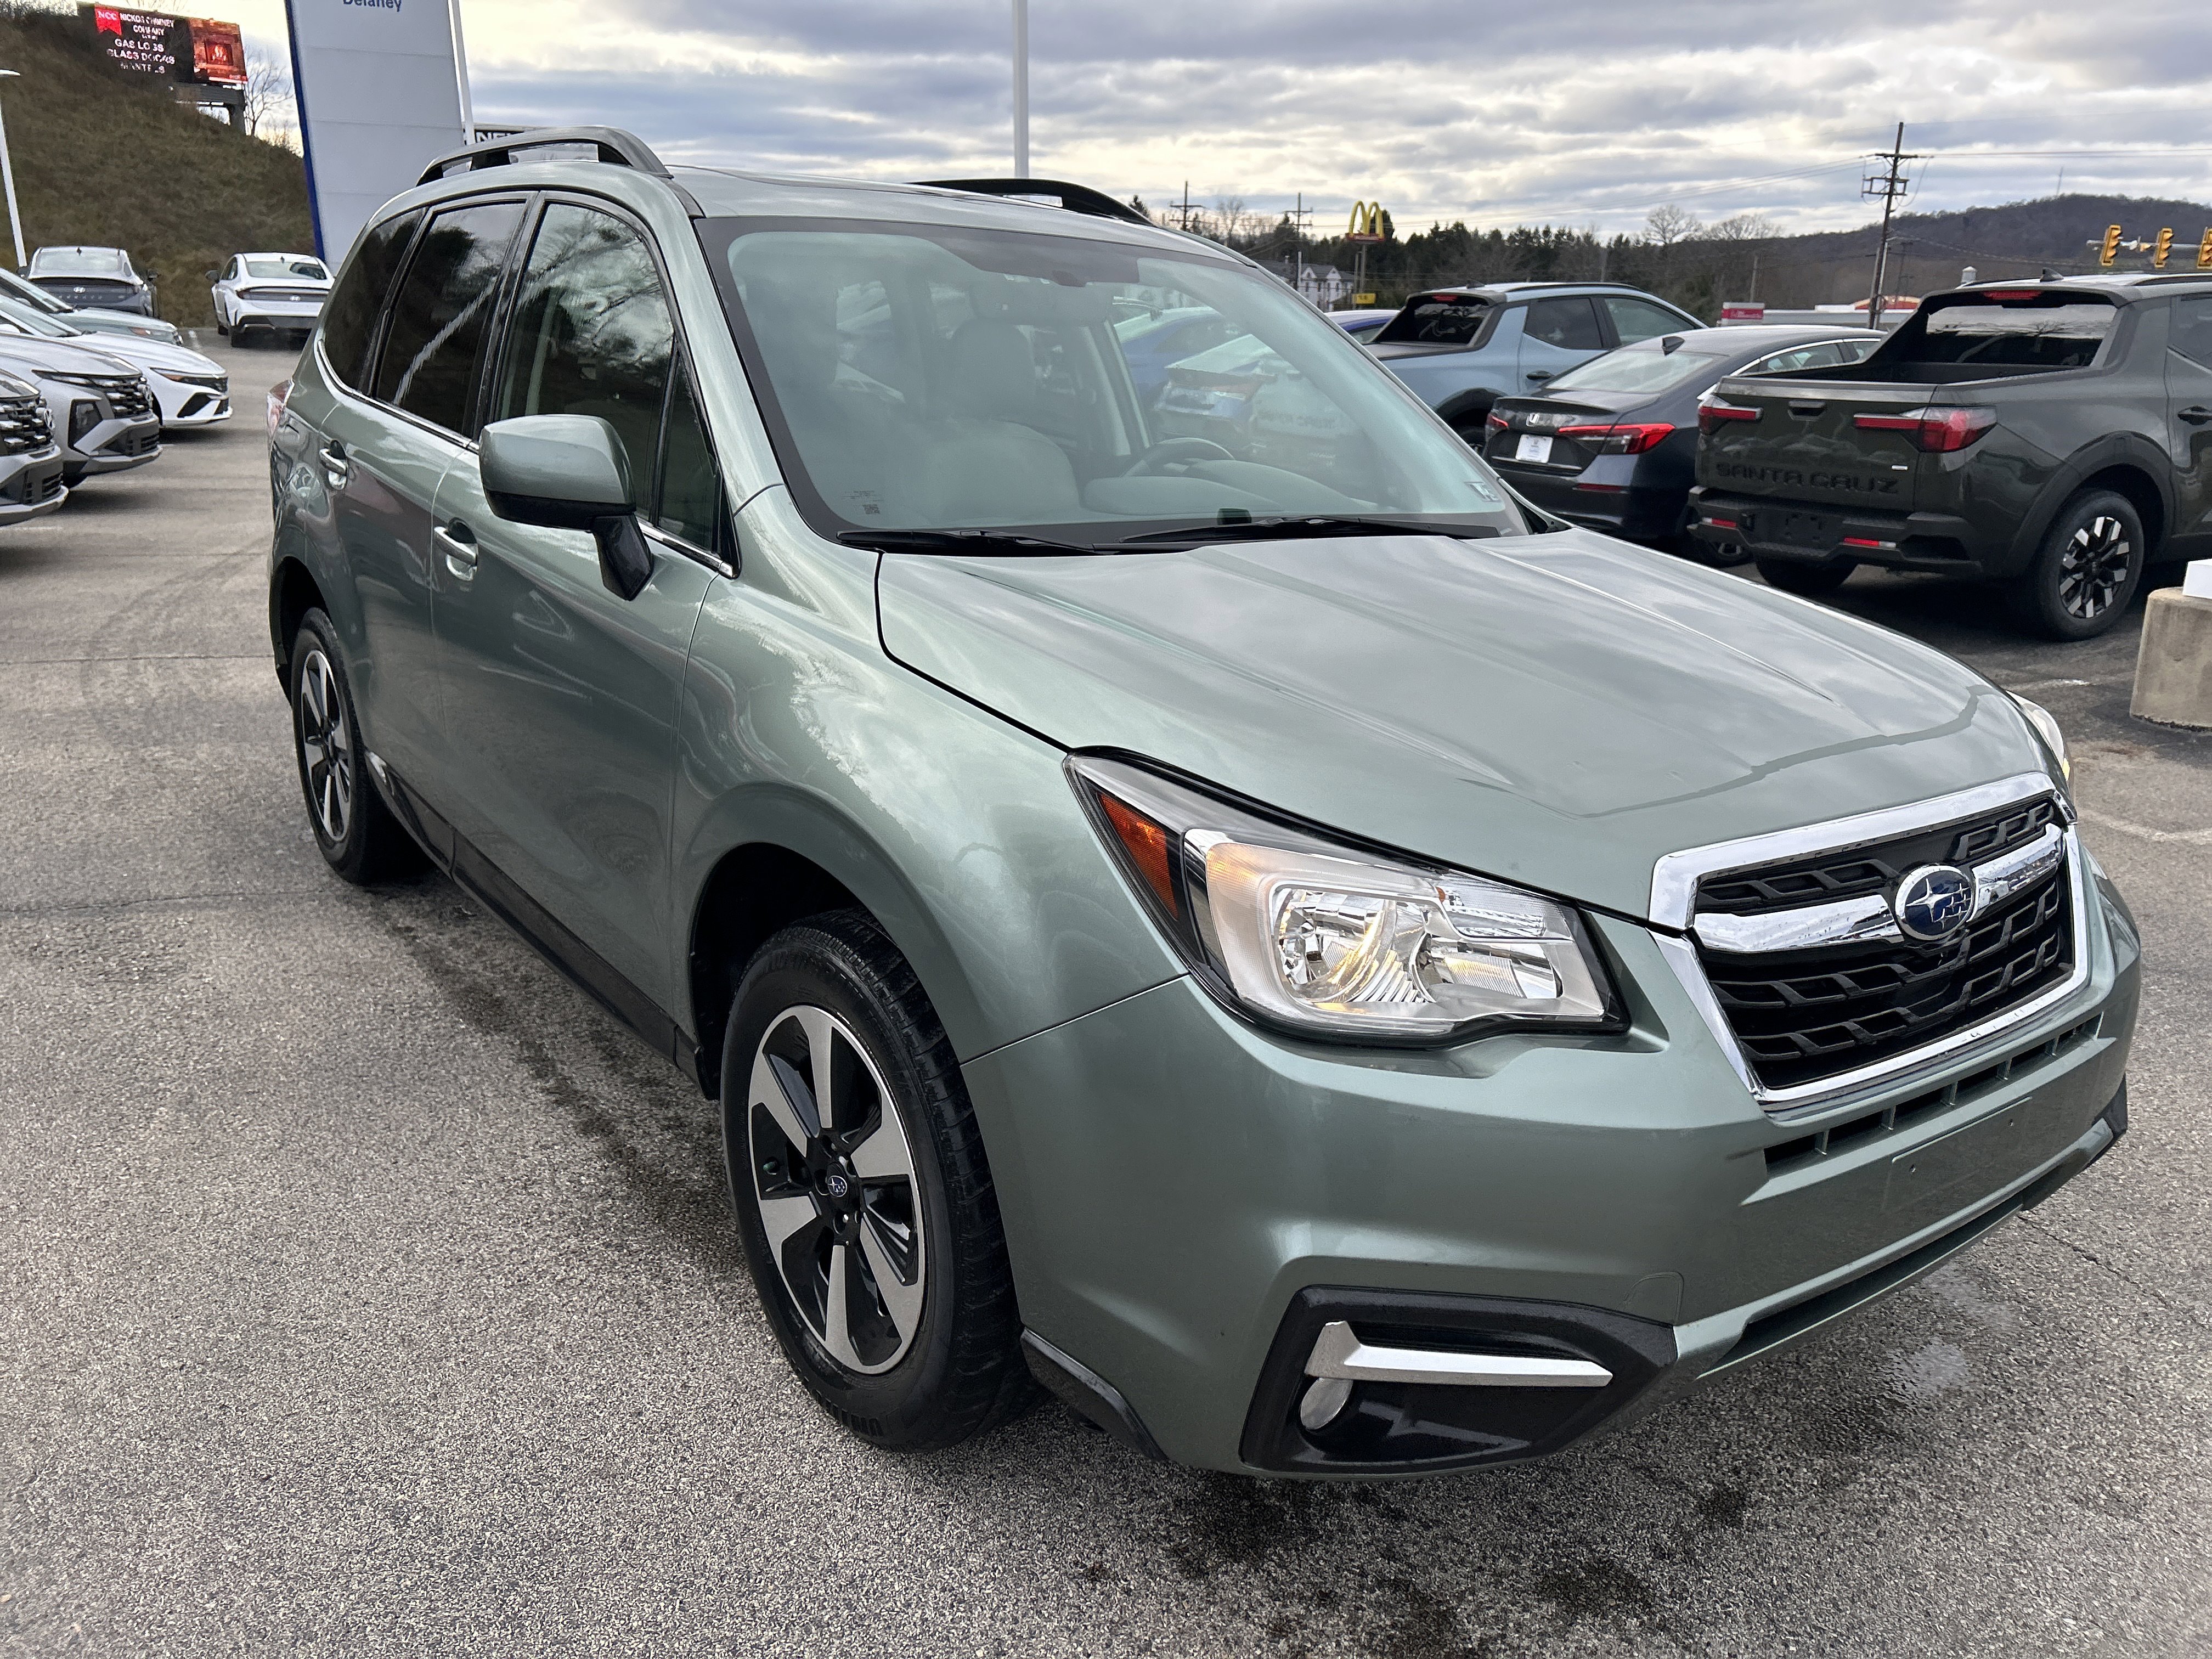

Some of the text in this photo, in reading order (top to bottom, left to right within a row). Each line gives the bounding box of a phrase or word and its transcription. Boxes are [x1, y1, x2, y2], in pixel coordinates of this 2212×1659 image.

[98, 11, 117, 20] NCC
[115, 38, 136, 49] GAS
[107, 48, 140, 60] GLASS
[120, 61, 165, 74] MNTES
[1716, 462, 1898, 494] SANTA CRUZ
